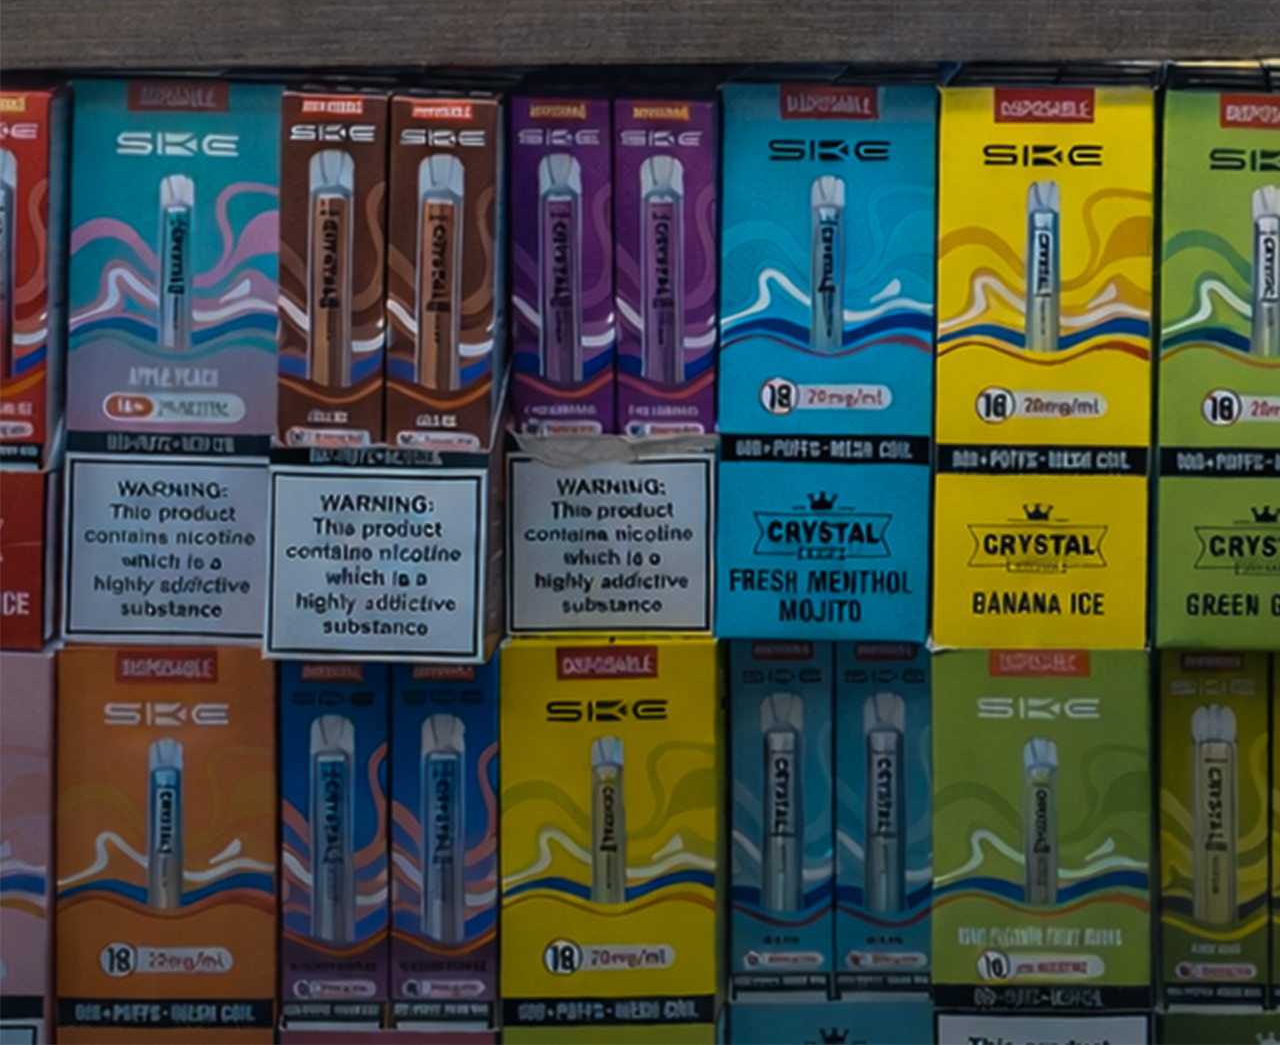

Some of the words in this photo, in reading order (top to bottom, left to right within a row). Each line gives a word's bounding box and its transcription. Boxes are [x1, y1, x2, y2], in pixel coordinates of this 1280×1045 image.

[116, 131, 240, 157] SKE
[290, 124, 376, 142] SKE
[400, 128, 486, 147] SKE
[768, 139, 892, 163] SKE
[982, 144, 1103, 167] SKE
[807, 388, 883, 408] 20mg/ml
[1210, 396, 1234, 421] 18
[118, 480, 229, 499] WARNING:
[556, 478, 667, 496] WARNING:
[158, 505, 236, 525] product
[320, 494, 435, 514] WARNING:
[597, 502, 674, 523] product
[84, 529, 169, 546] contains
[361, 520, 443, 541] product
[766, 520, 881, 545] CRYSTAL
[983, 533, 1096, 556] CRYSTAL
[122, 553, 181, 571] which
[210, 557, 222, 571] a
[563, 549, 622, 567] which
[93, 575, 155, 597] highly
[159, 576, 251, 594] addictive
[325, 568, 385, 586] which
[534, 572, 595, 593] highly
[600, 572, 689, 590] addictive
[729, 569, 798, 594] FRESH
[806, 569, 913, 594] MENTHOL
[2, 592, 30, 616] CE
[120, 600, 223, 618] substance
[295, 592, 356, 614] highly
[364, 593, 456, 613] addictive
[778, 598, 862, 623] MOJITO
[972, 592, 1062, 615] BANANA
[1070, 592, 1105, 616] ICE
[1186, 593, 1259, 617] GREEN
[103, 702, 230, 726] SKE
[546, 699, 668, 723] SKE
[977, 697, 1101, 719] SKE
[107, 947, 132, 973] 18
[550, 944, 575, 972] 18
